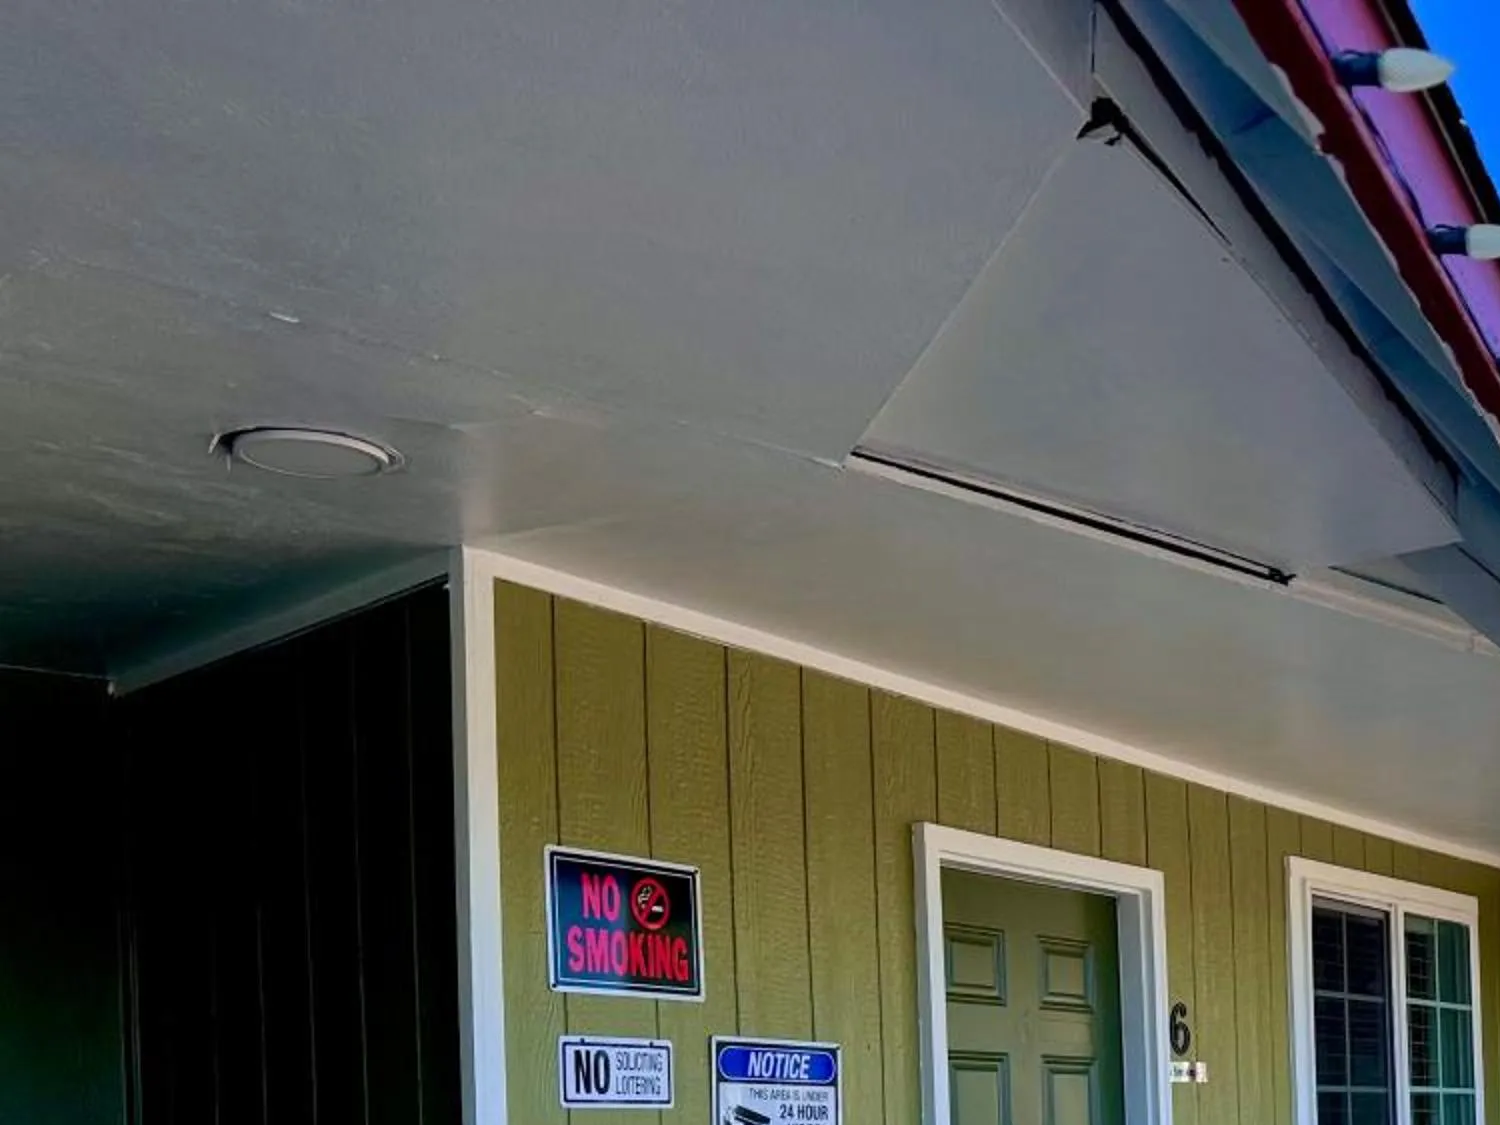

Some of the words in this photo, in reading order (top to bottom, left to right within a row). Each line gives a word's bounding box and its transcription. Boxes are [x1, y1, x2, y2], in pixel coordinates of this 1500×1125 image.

[581, 872, 621, 922] NO
[567, 924, 689, 982] SMOKING
[1169, 1001, 1191, 1057] 6
[574, 1049, 610, 1095] NO
[747, 1051, 811, 1080] NOTICE
[615, 1075, 661, 1095] LOITERING
[750, 1087, 769, 1100] THIS
[770, 1088, 791, 1101] AREA
[780, 1103, 795, 1119] 24
[797, 1104, 829, 1121] HOUR
